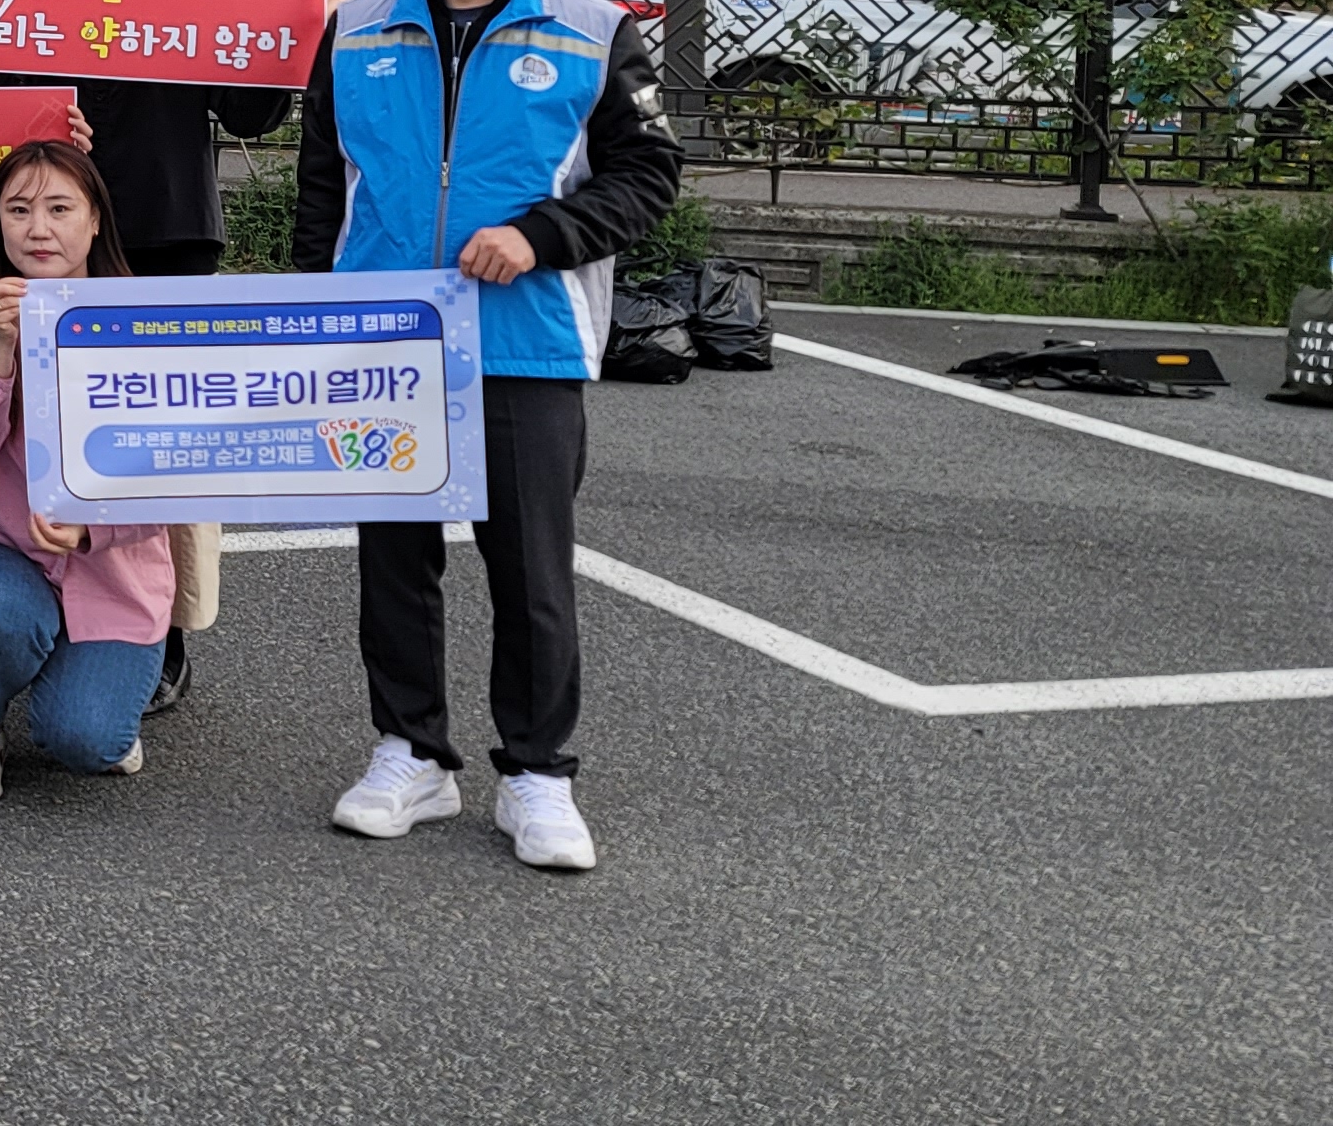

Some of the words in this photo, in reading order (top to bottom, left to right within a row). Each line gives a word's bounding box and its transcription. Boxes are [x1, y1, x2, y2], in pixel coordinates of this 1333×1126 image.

[80, 17, 197, 59] 약하지
[214, 22, 297, 69] 않아
[132, 321, 181, 335] 경상남도
[185, 320, 209, 334] 연합
[265, 315, 318, 335] 청소년
[321, 314, 356, 334] 응원
[361, 312, 420, 332] 캠페인!
[87, 372, 158, 409] 갇힌
[166, 371, 238, 408] 마음
[245, 369, 316, 406] 같이
[326, 366, 420, 404] 열까?
[178, 430, 221, 447] 청소년
[224, 430, 238, 446] 및
[242, 427, 315, 445] 보호자에겐
[328, 429, 418, 472] 1388
[153, 449, 210, 469] 필요한
[214, 447, 253, 468] 순간
[258, 445, 315, 466] 언제든
